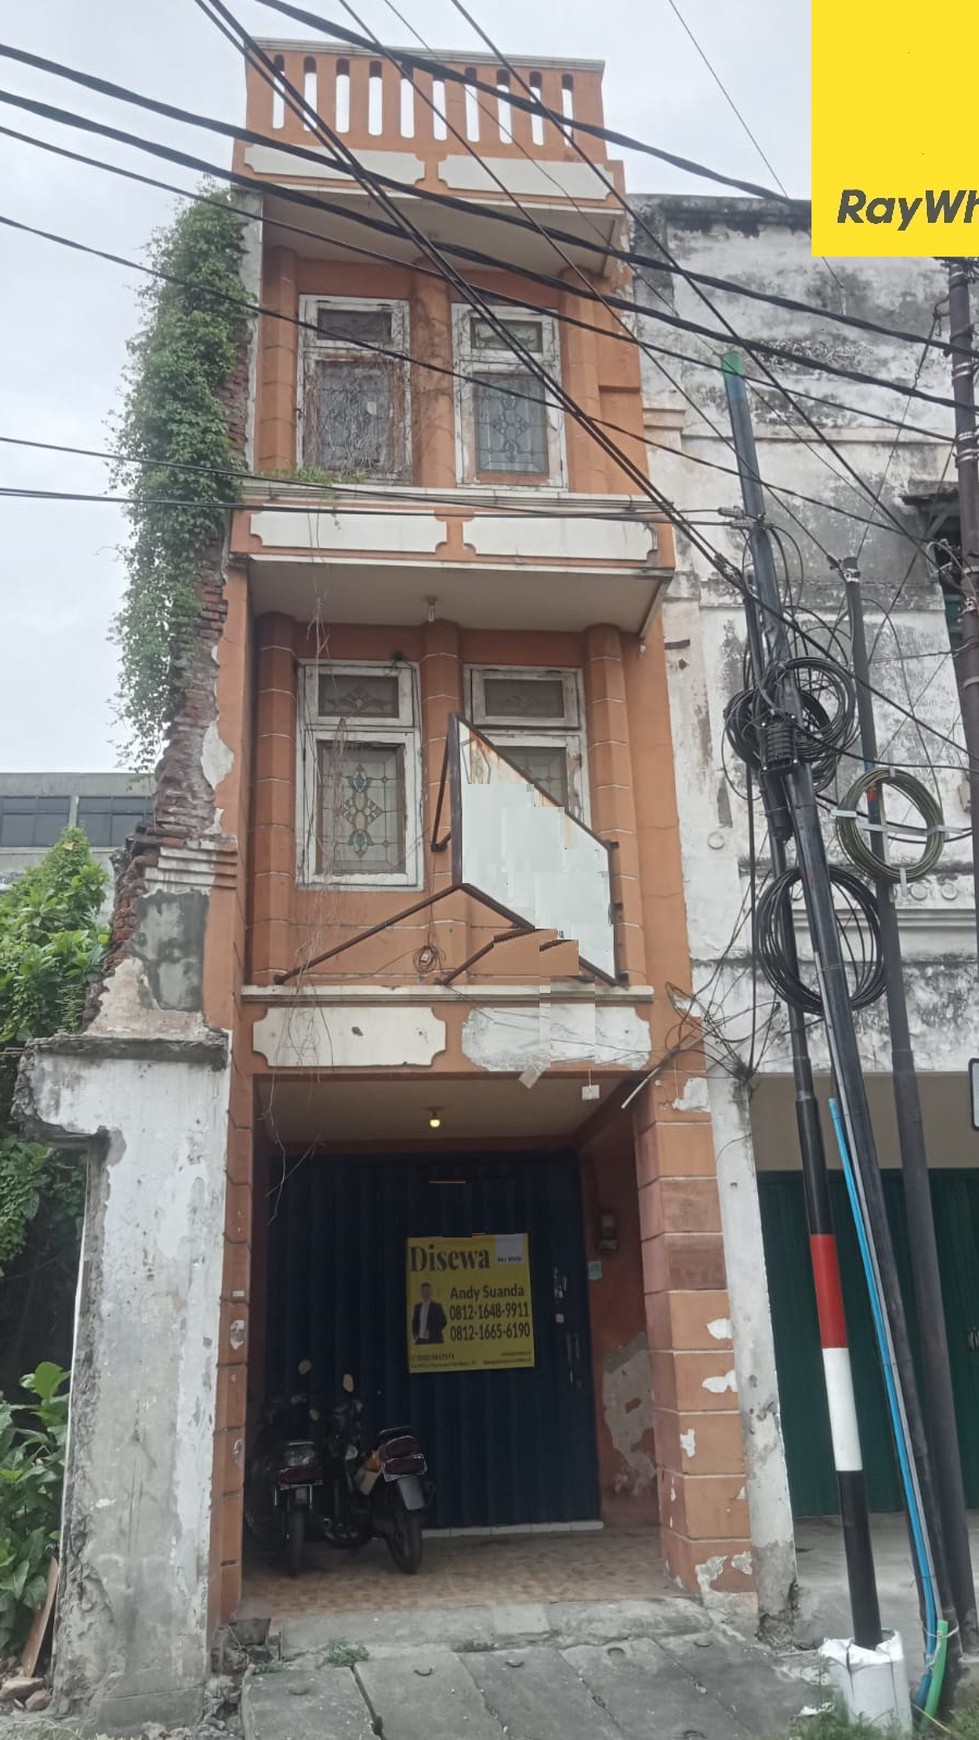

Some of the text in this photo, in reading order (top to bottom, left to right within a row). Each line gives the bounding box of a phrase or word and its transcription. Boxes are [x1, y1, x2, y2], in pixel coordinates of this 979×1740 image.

[409, 1244, 490, 1272] Disewa
[450, 1283, 525, 1302] Andy Suanda
[449, 1301, 529, 1321] 0812-1648-9911
[449, 1322, 531, 1341] 0812-1665-6190
